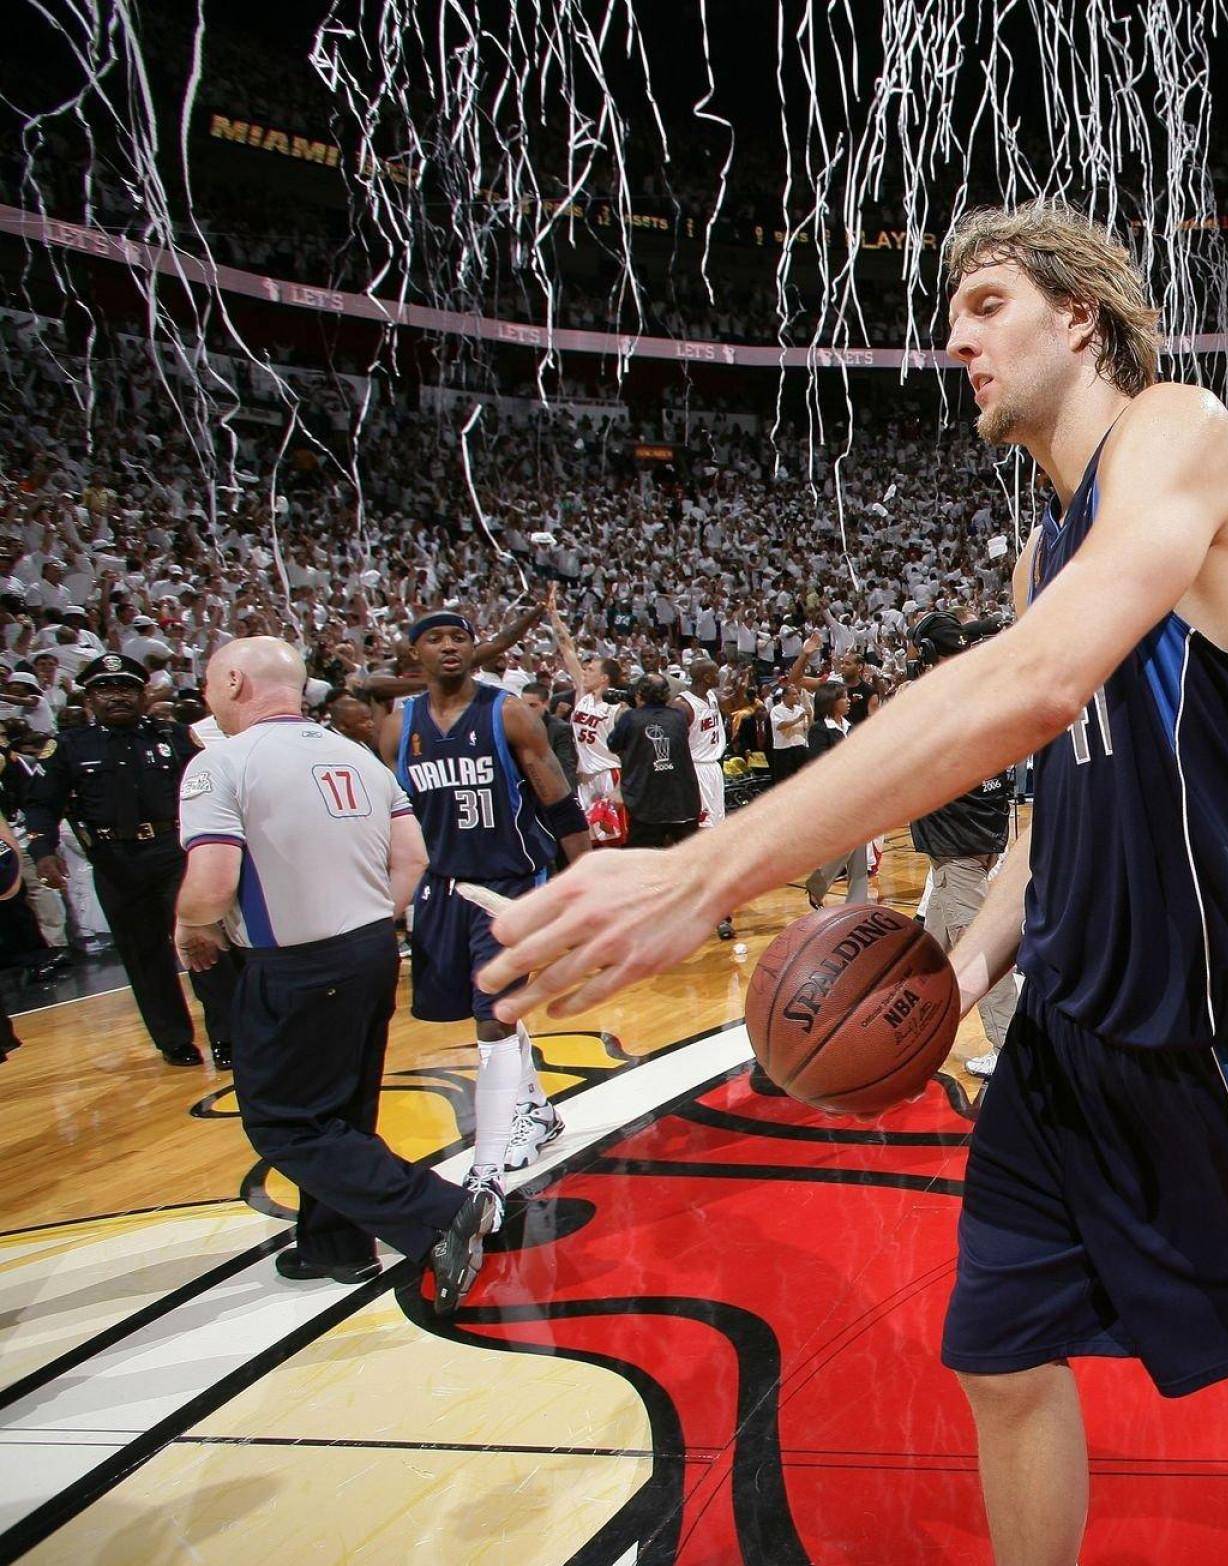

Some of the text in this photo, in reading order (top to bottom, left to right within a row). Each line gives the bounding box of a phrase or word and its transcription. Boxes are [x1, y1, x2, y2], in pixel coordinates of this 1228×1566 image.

[209, 112, 341, 169] MIAMI
[842, 229, 938, 250] LAYR
[573, 711, 608, 728] HEAT
[577, 728, 597, 744] 55
[320, 771, 358, 811] 17
[408, 756, 494, 792] DALLAS
[454, 788, 495, 829] 31
[783, 911, 902, 1034] SPALDING
[883, 989, 920, 1029] NBA
